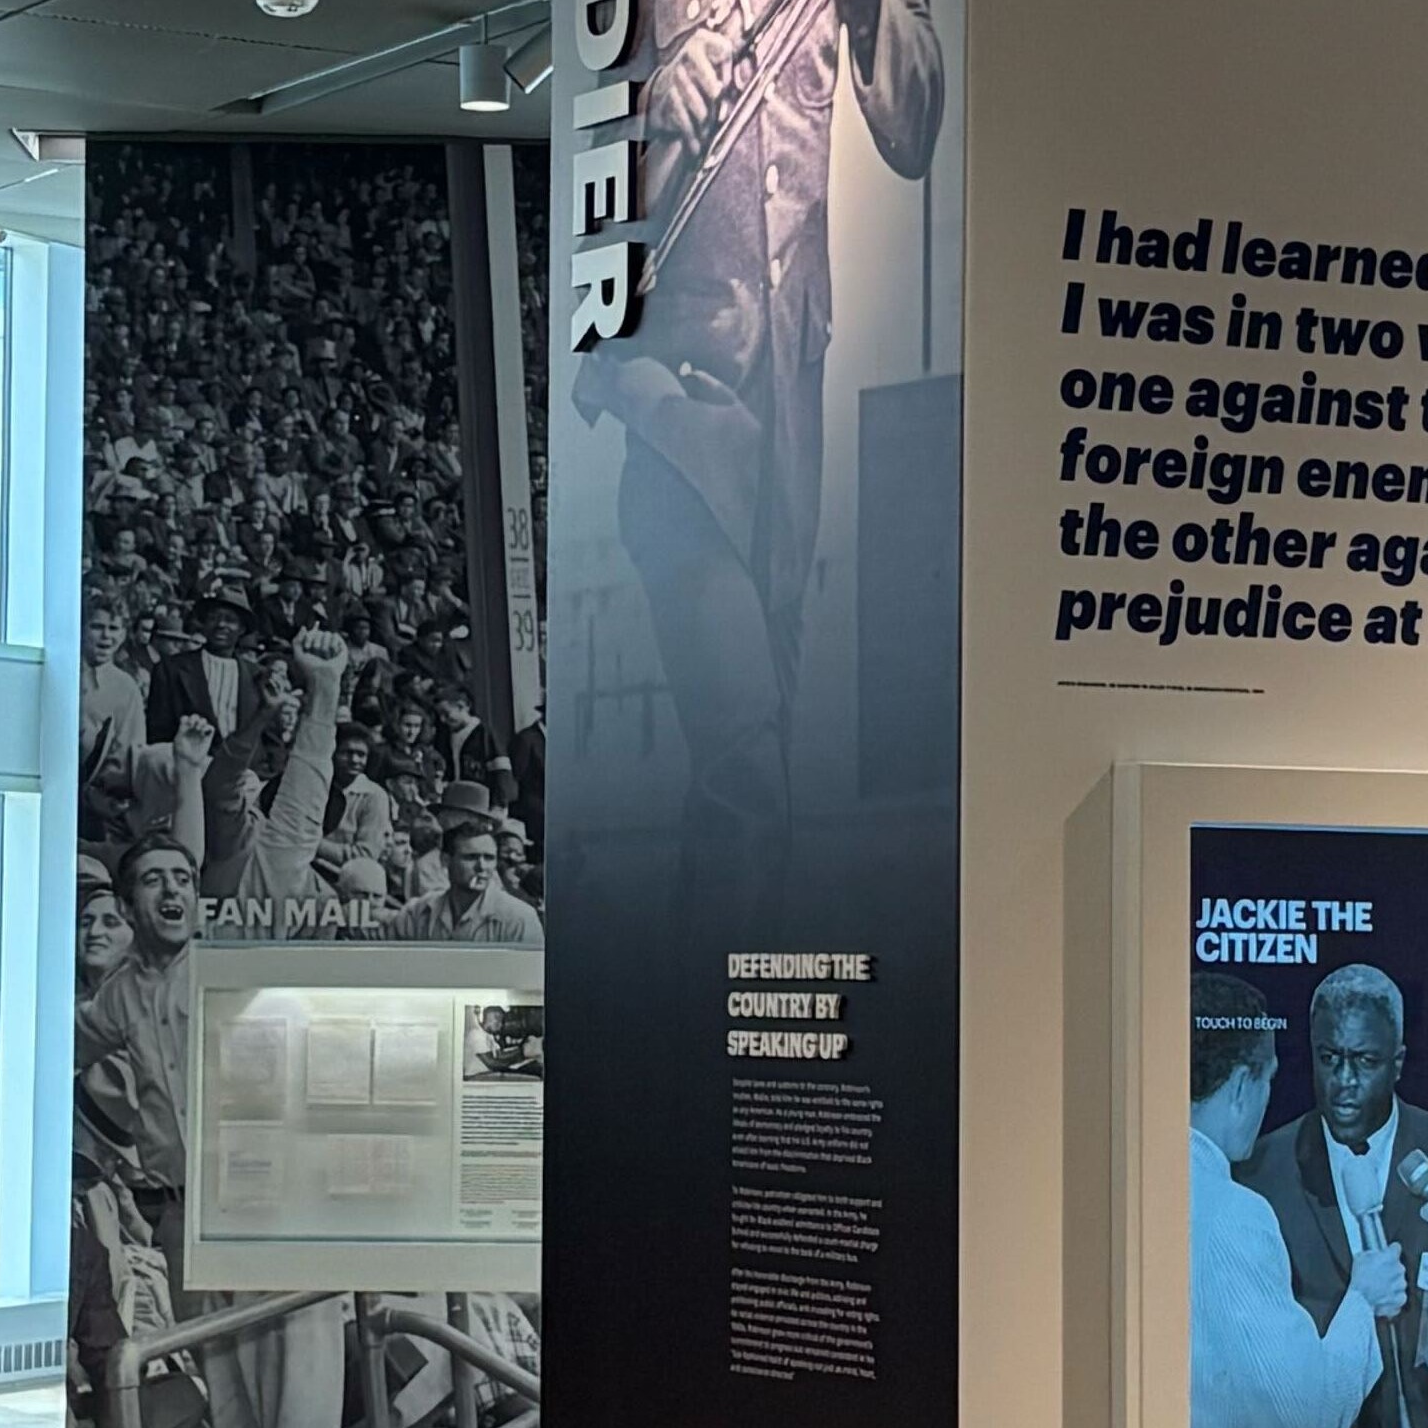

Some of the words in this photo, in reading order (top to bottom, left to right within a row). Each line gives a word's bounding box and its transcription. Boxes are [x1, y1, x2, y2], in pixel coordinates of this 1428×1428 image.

[1062, 209, 1086, 260] I
[1097, 210, 1213, 272] had
[1062, 282, 1085, 333] I
[1098, 299, 1214, 344] was
[1227, 293, 1282, 349] in
[1296, 309, 1404, 358] two
[1061, 369, 1173, 414] one
[1185, 372, 1408, 432] against
[1061, 427, 1285, 504] foreign
[508, 507, 529, 550] 38
[1061, 503, 1159, 559] the
[1172, 512, 1336, 568] other
[513, 609, 535, 652] 39
[1055, 579, 1352, 645] prejudice
[1363, 598, 1422, 645] at
[198, 898, 272, 927] FAN
[285, 898, 380, 928] MAIL
[1196, 898, 1306, 930] JACKIE
[1312, 901, 1373, 932] THE
[728, 953, 830, 980] DEFENDING
[831, 954, 871, 981] THE
[1196, 932, 1318, 964] CITIZEN
[728, 992, 812, 1018] COUNTRY
[816, 994, 841, 1019] BY
[1196, 1017, 1234, 1029] TOUCH
[1237, 1017, 1253, 1030] TO
[1254, 1017, 1287, 1030] BEGIN
[727, 1030, 819, 1058] SPEAKING
[819, 1033, 848, 1060] UP
